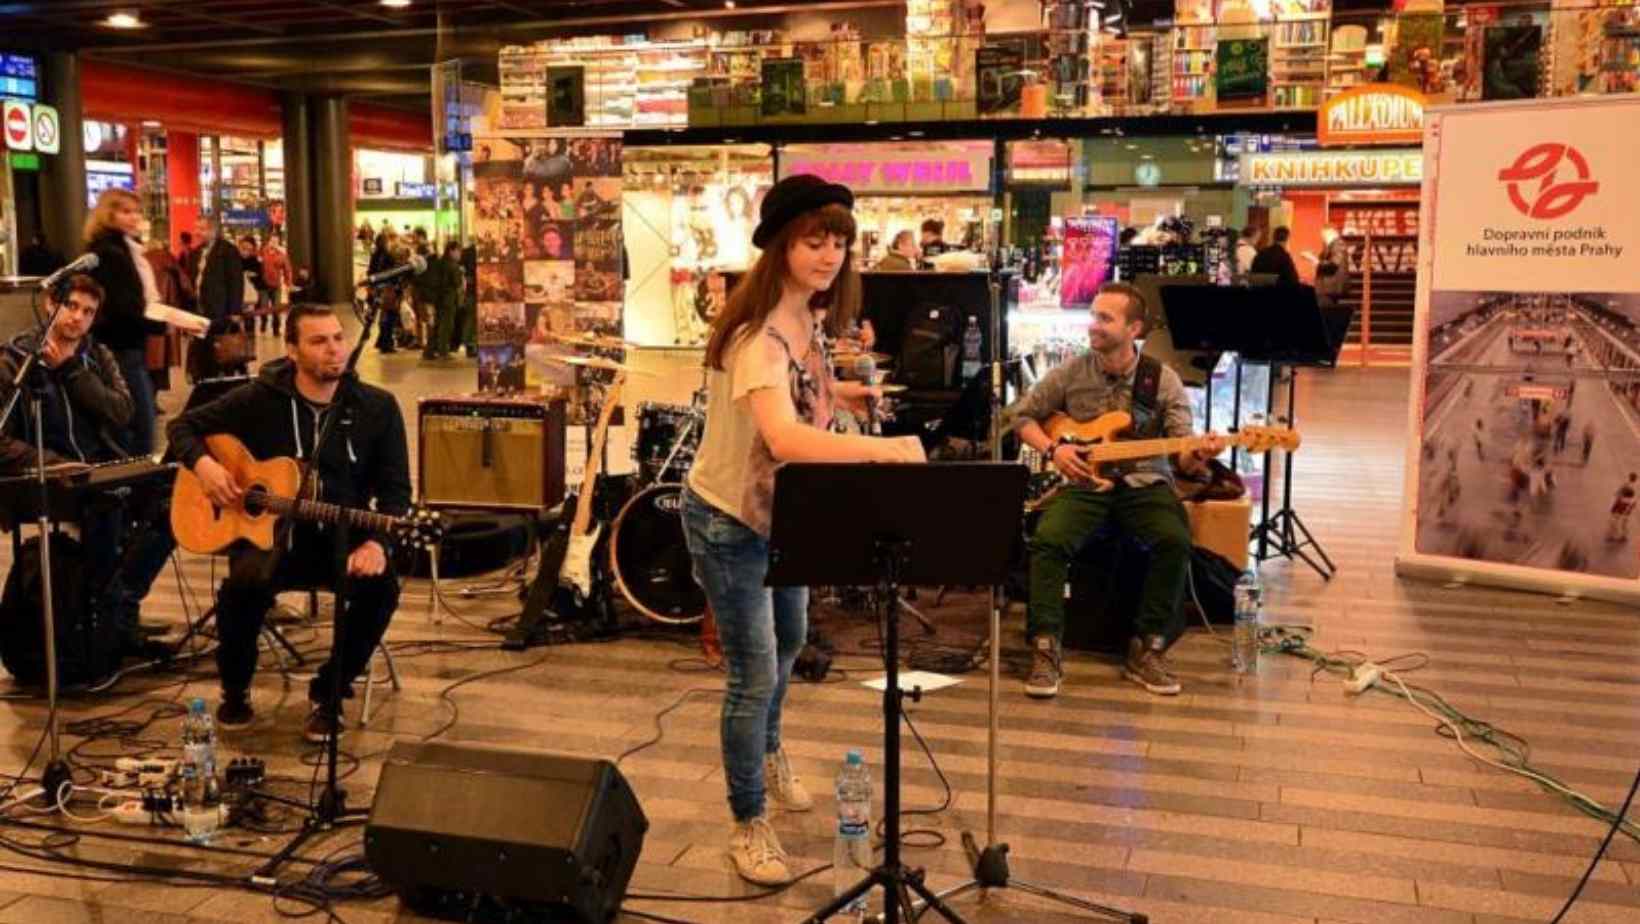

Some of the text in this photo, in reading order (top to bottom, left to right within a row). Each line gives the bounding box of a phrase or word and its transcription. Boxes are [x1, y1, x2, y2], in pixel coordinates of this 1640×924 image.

[1328, 92, 1423, 131] PALLADIUM
[1483, 225, 1606, 242] Dopravní podnik
[1466, 242, 1623, 259] hlavního města Prahy
